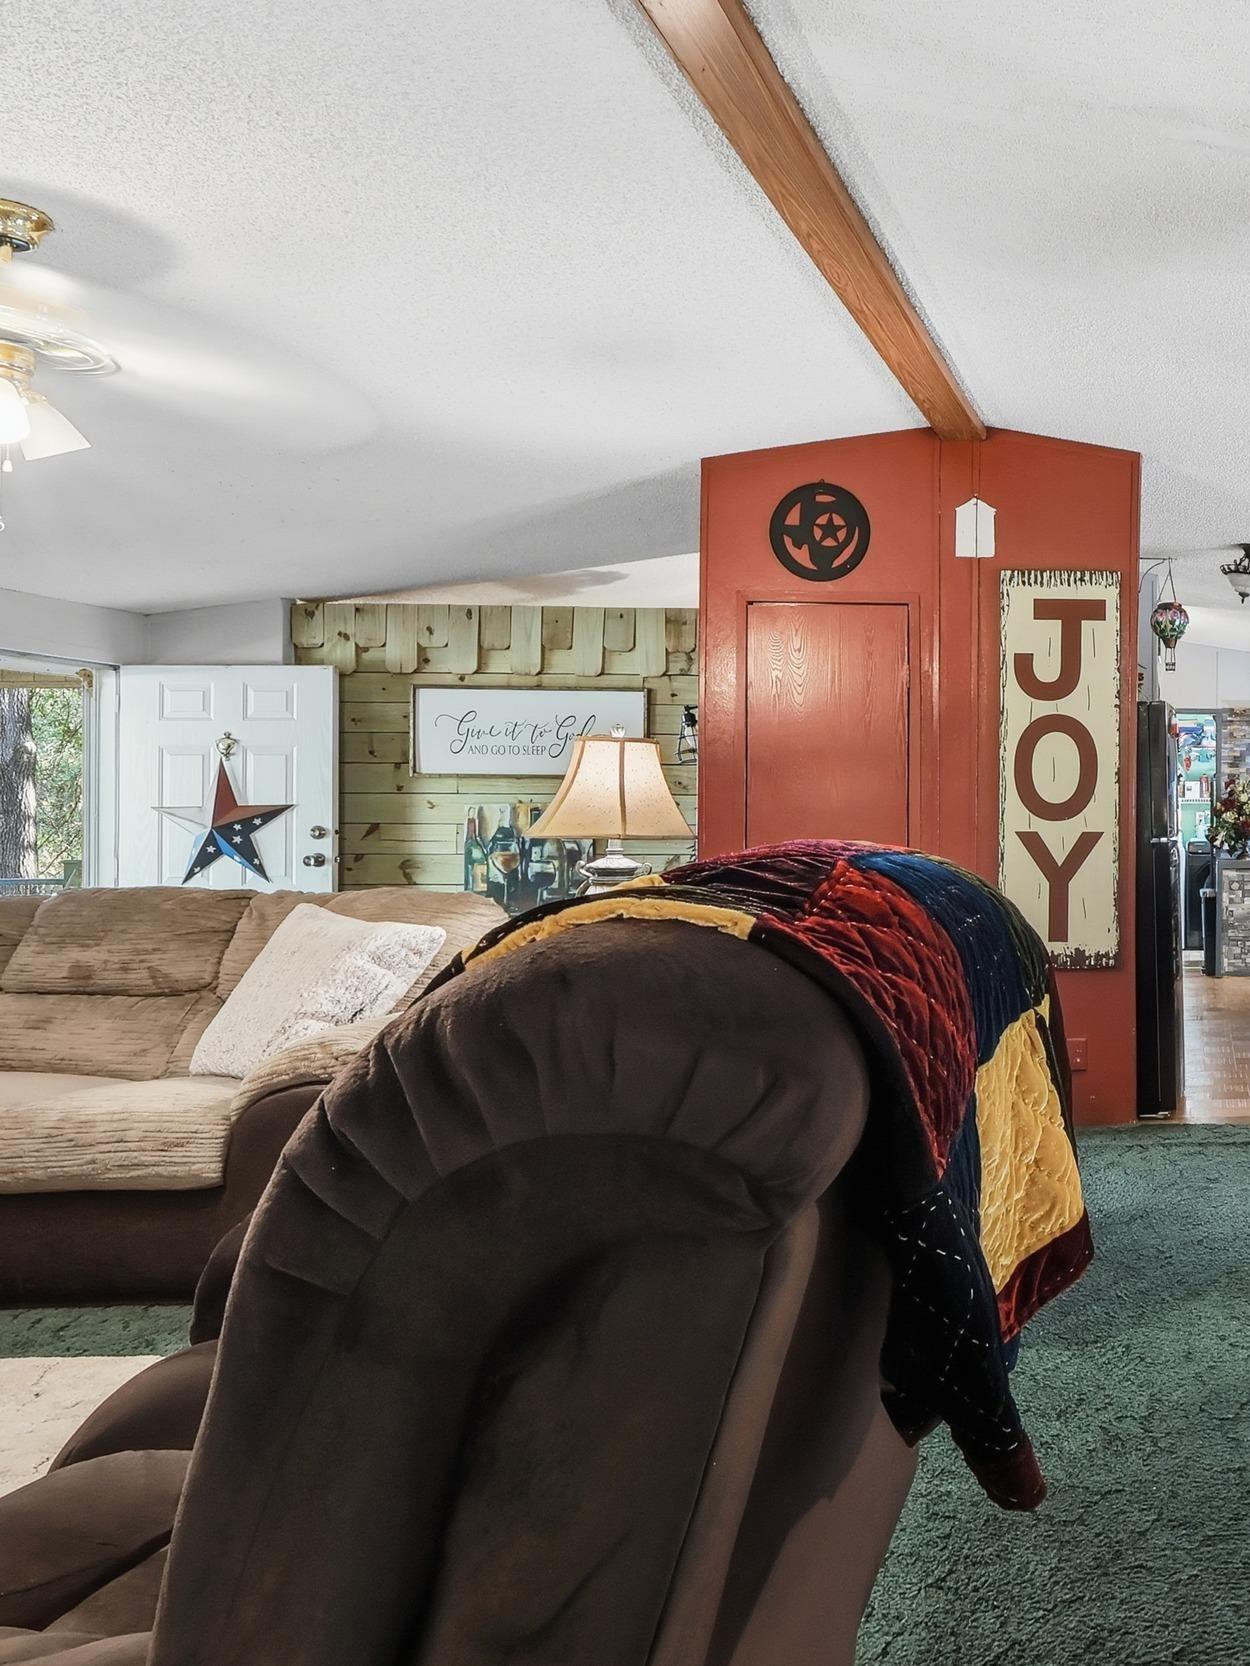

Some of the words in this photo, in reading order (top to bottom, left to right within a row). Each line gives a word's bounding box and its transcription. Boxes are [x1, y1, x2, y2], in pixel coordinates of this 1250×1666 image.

[435, 710, 501, 754] Give
[504, 719, 527, 741] it
[524, 721, 552, 744] to
[549, 714, 597, 759] God
[467, 744, 489, 755] AND
[490, 744, 505, 756] GO
[506, 745, 520, 756] TO
[522, 745, 546, 756] SLEEP
[1014, 598, 1106, 942] JOY
